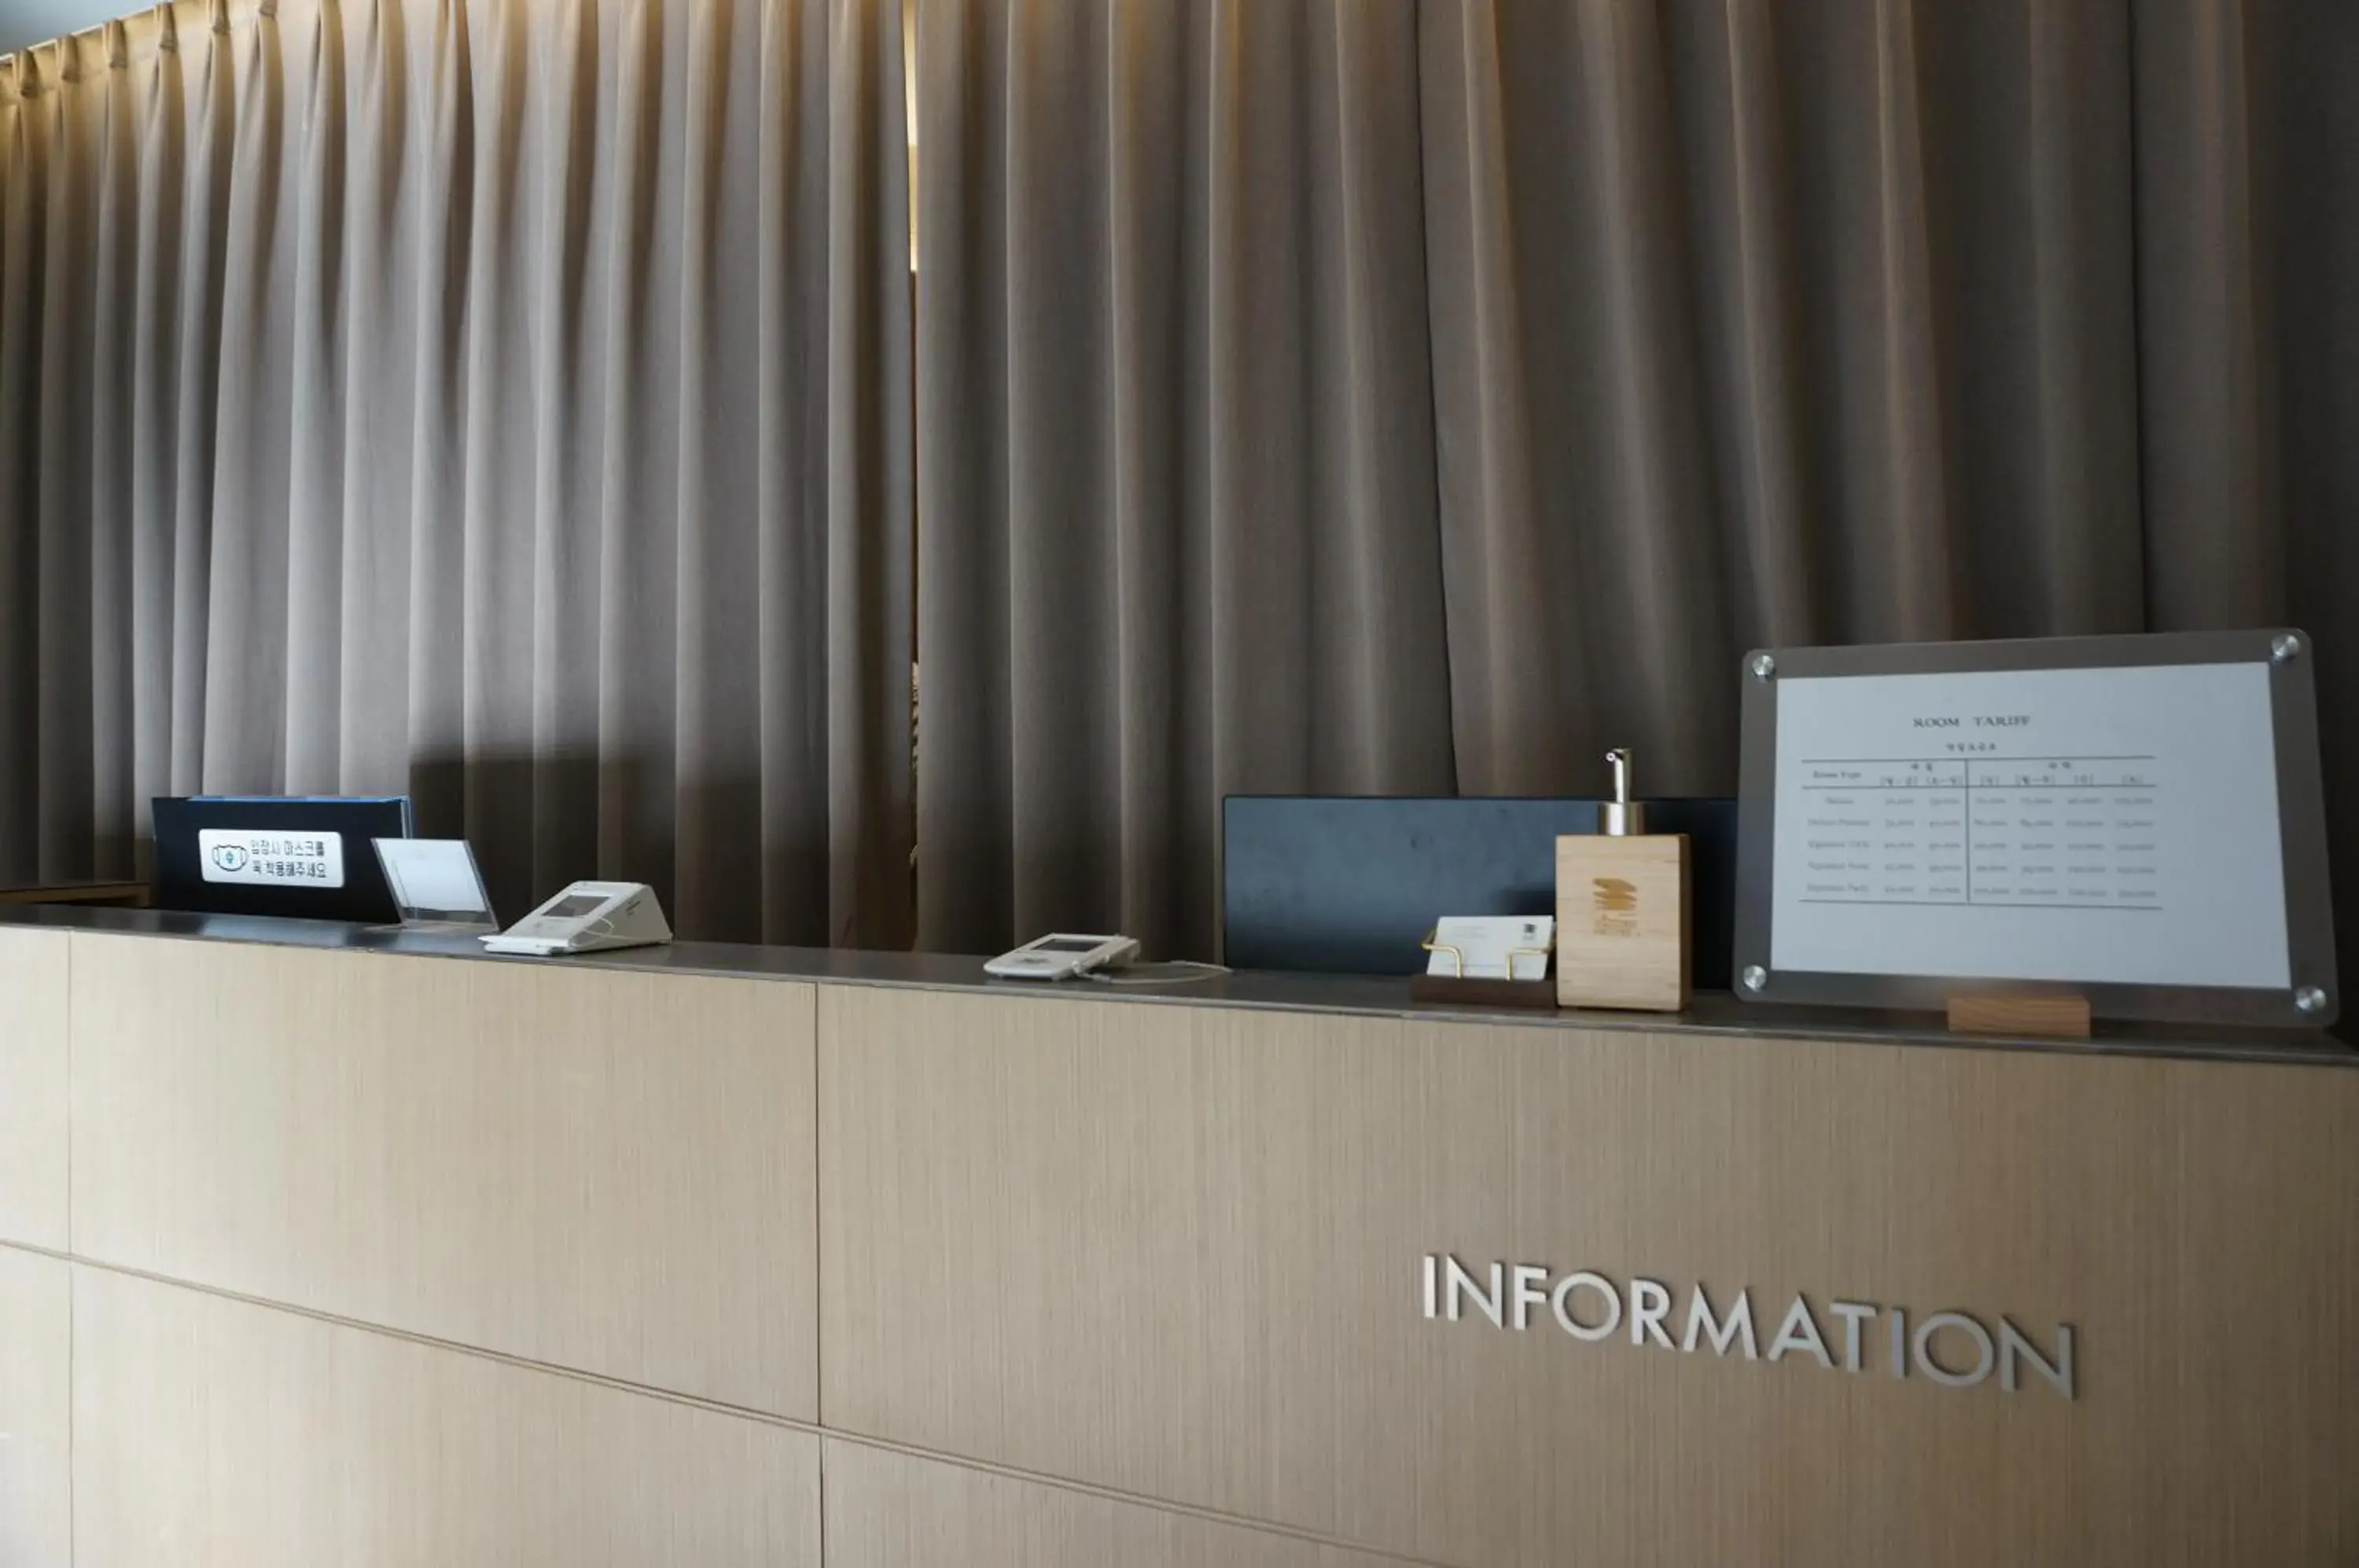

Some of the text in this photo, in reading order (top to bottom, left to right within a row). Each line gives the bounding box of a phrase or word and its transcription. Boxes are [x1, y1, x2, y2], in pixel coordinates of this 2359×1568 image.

[1913, 716, 2030, 727] ROOM TARIFF
[284, 840, 325, 857] 마스크를
[266, 861, 327, 878] 착용해주세요
[1422, 1253, 2076, 1402] INFORMATION
